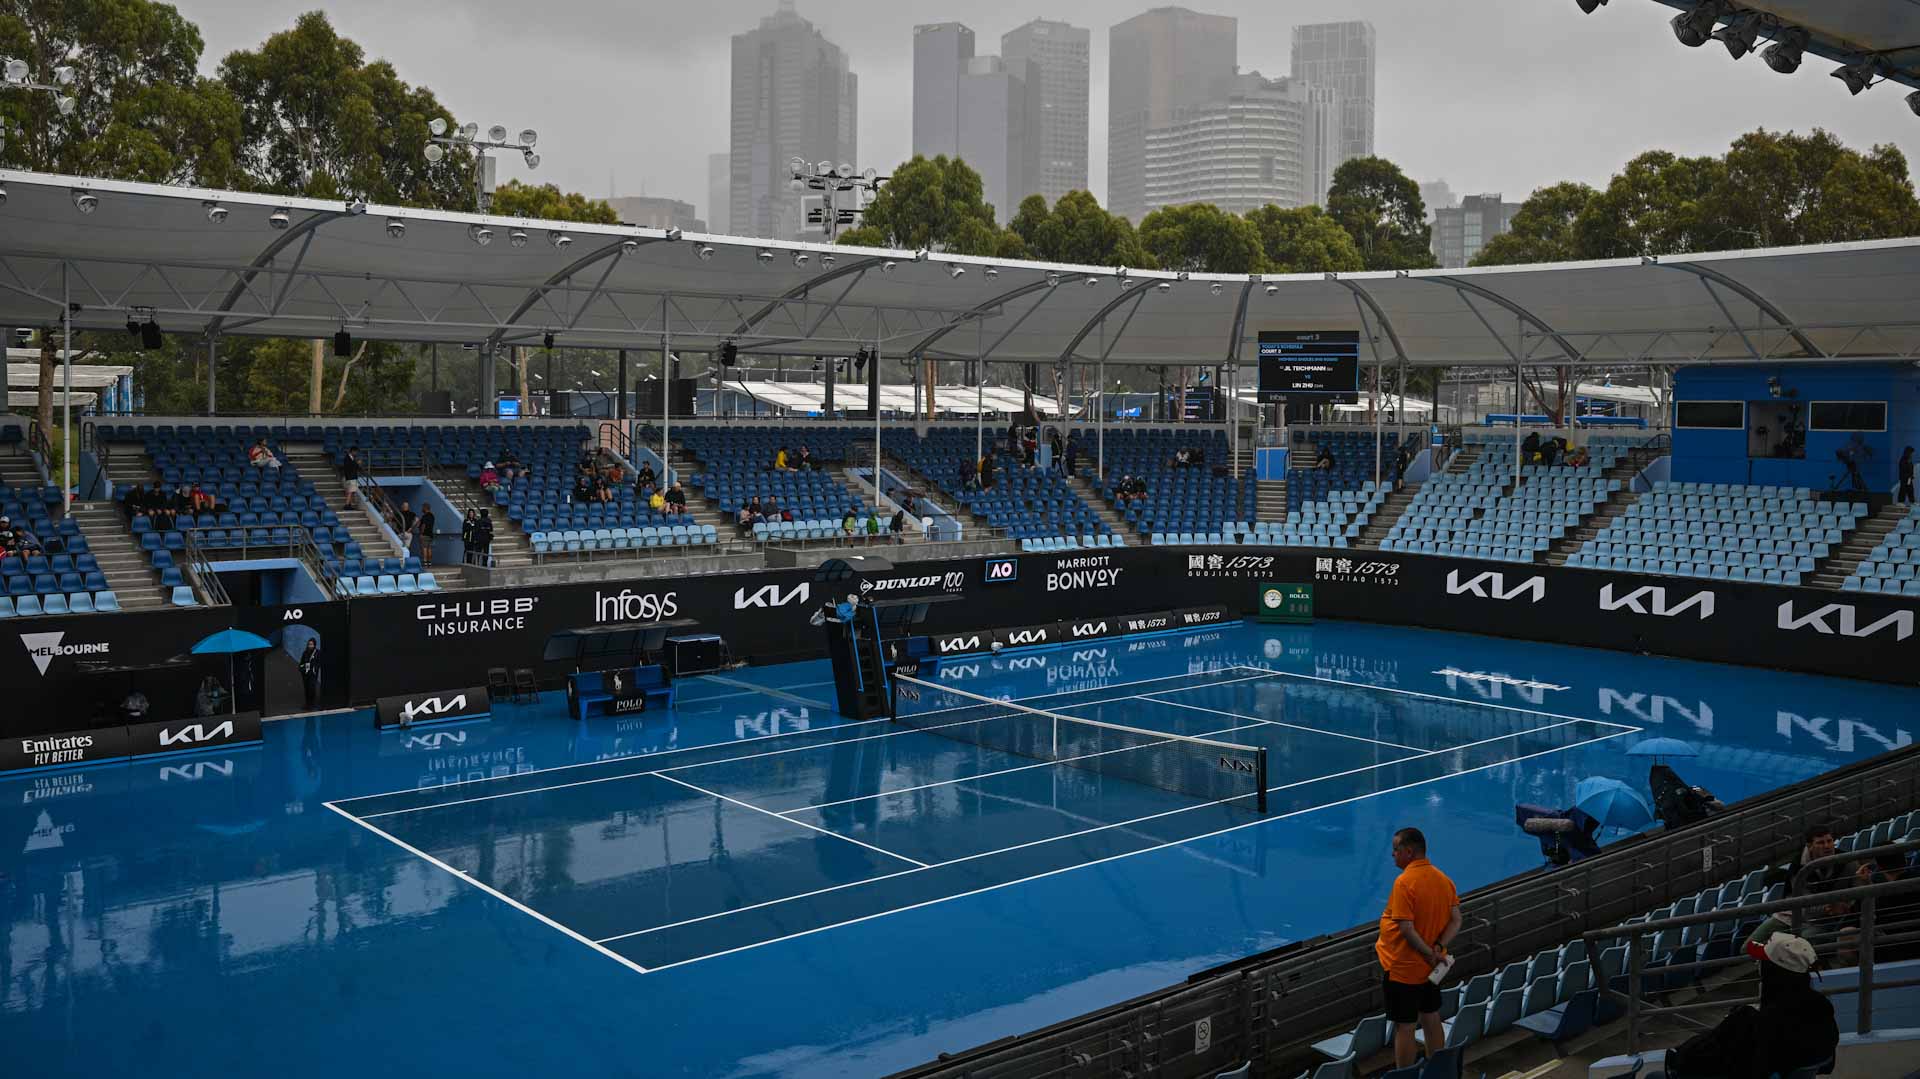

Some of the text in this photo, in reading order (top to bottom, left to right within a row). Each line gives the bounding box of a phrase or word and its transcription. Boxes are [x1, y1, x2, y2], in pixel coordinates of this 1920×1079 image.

[991, 563, 1012, 577] AO
[1058, 556, 1110, 569] MARRIOTT
[873, 572, 965, 590] DUNLOP 100
[1047, 568, 1119, 591] BONVOY
[1315, 573, 1399, 585] GUOJIAO 1573
[1446, 569, 1545, 602] KIA
[735, 582, 809, 609] KIA
[1600, 583, 1714, 619] KIA
[596, 589, 677, 621] Infosys
[284, 609, 303, 620] AO
[1778, 600, 1913, 641] KIA
[428, 616, 525, 636] INSURANCE
[1073, 622, 1107, 637] KIA
[940, 635, 980, 653] KIA
[1009, 629, 1047, 645] KIA
[29, 642, 110, 657] MELBOURNE
[616, 698, 643, 710] POLO
[159, 721, 233, 745] KIA
[22, 736, 93, 754] Emirates
[35, 749, 83, 765] FLY BETTER
